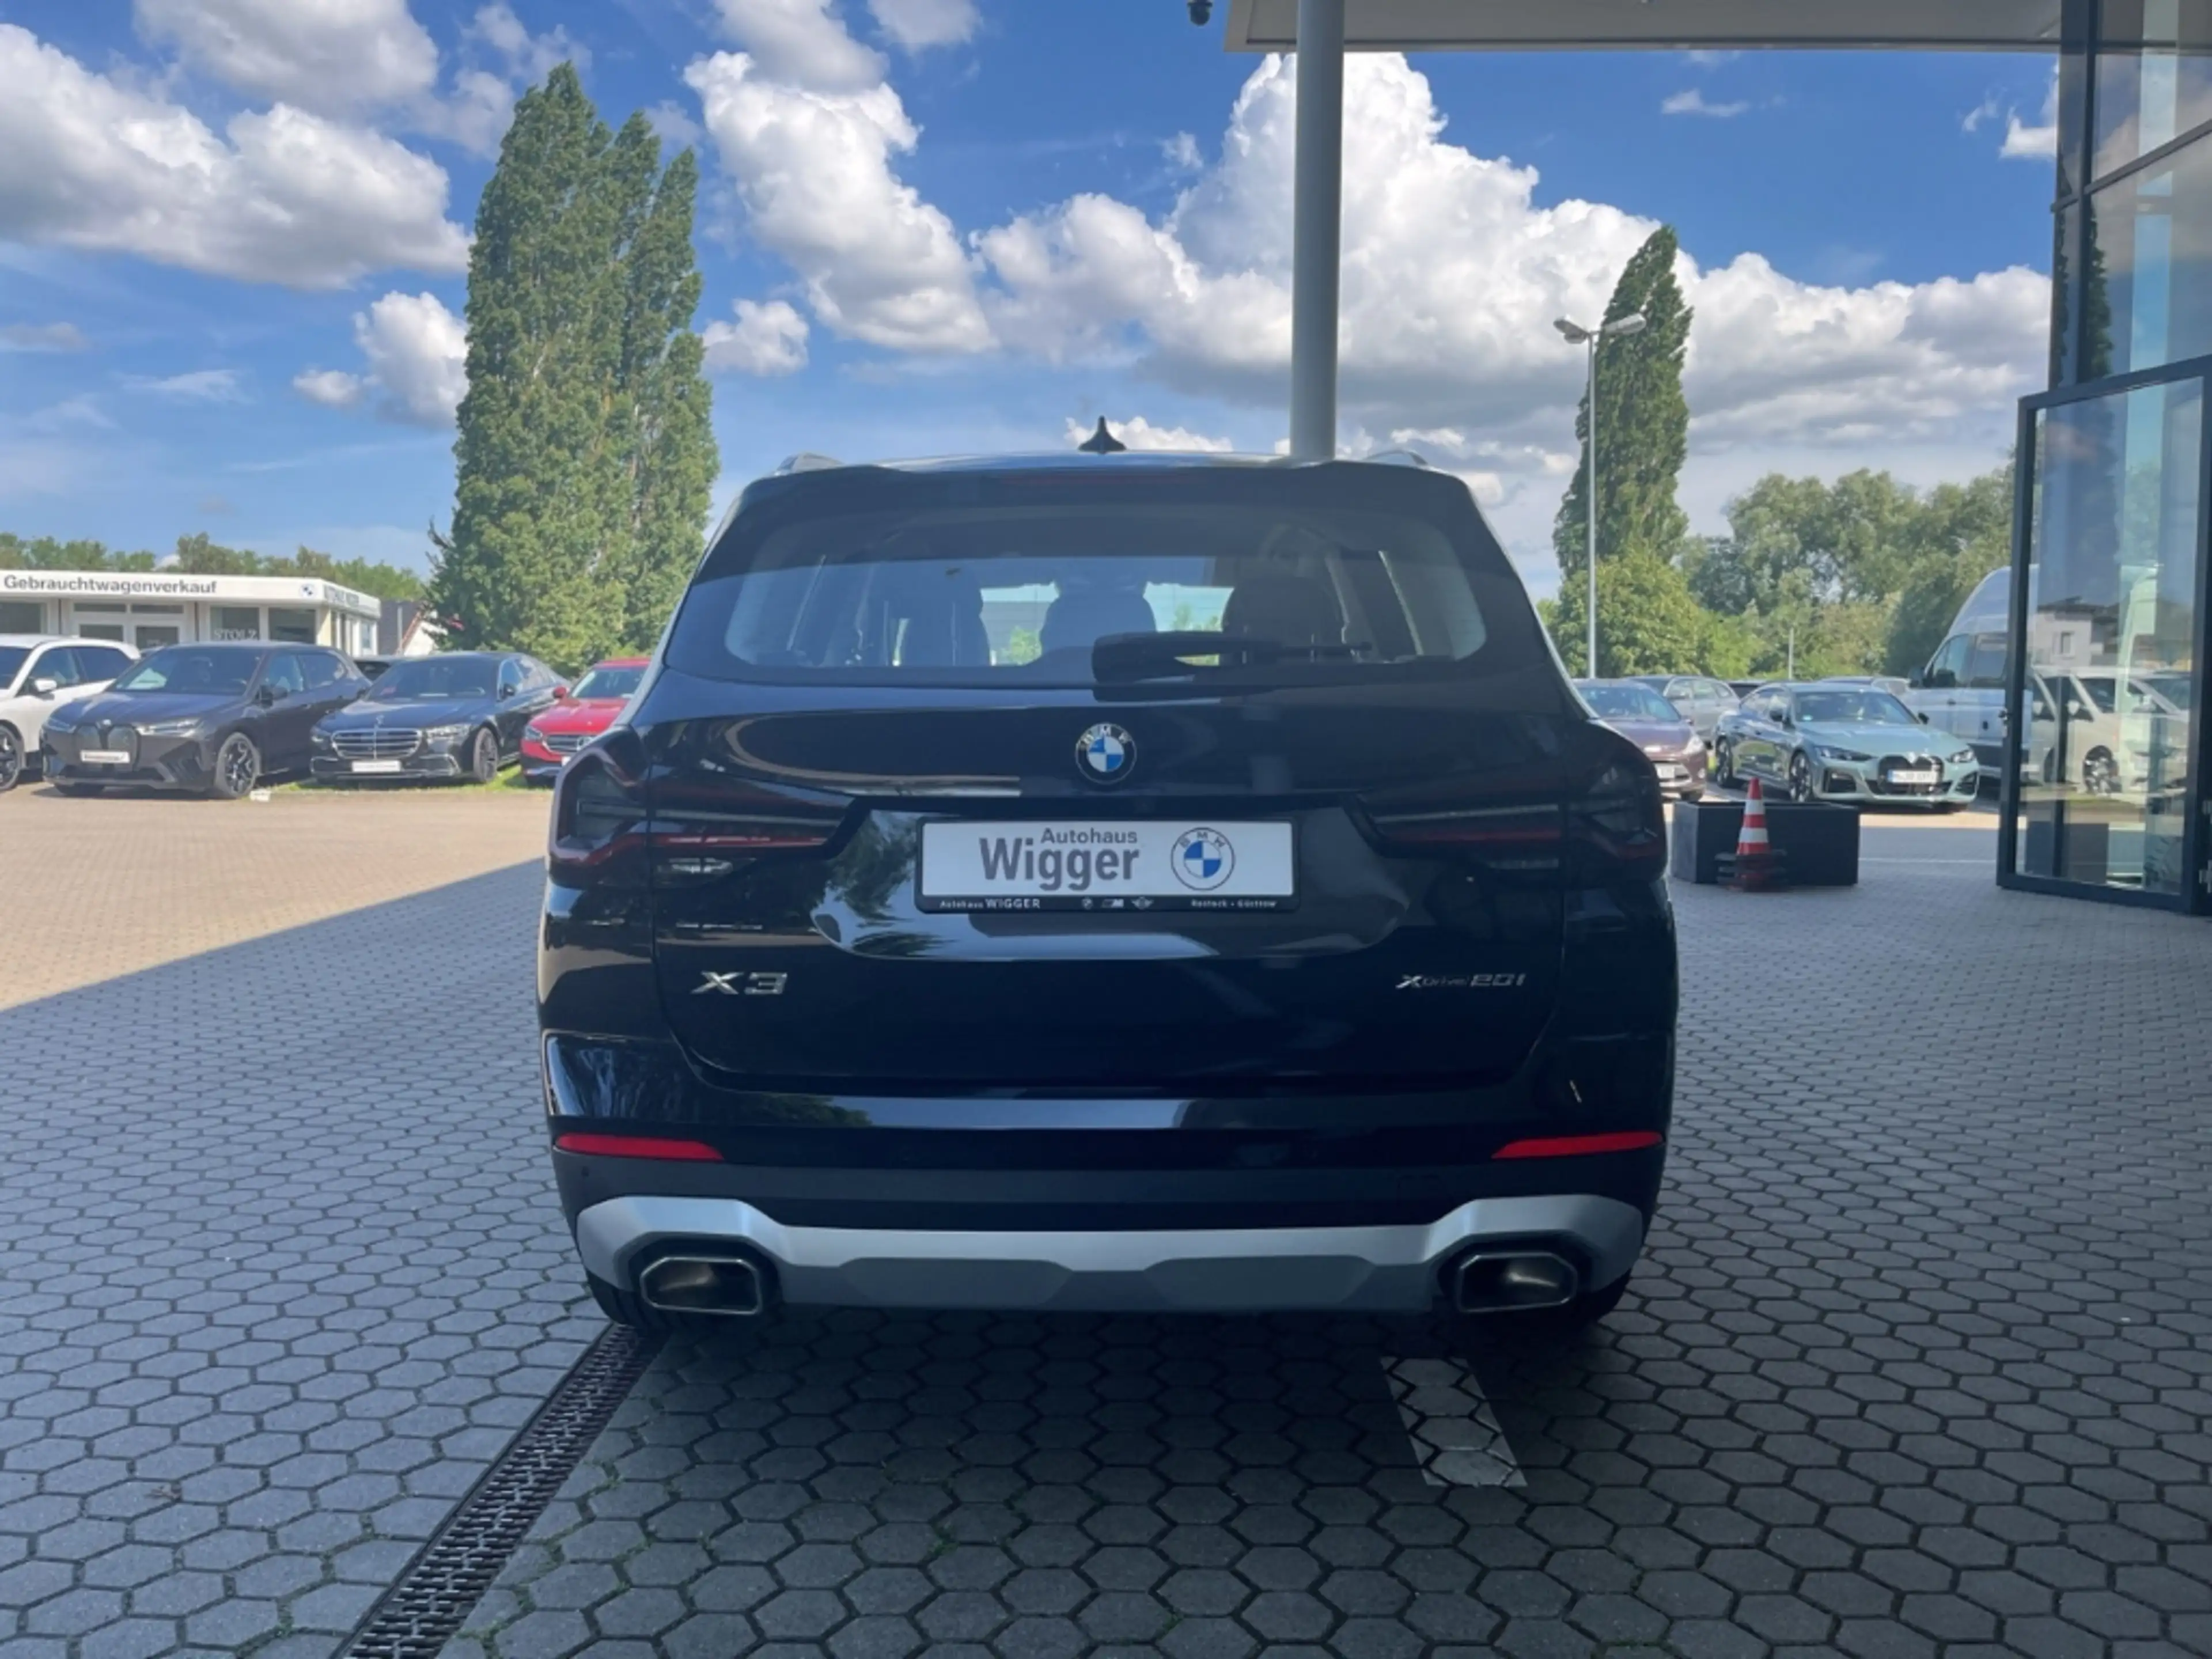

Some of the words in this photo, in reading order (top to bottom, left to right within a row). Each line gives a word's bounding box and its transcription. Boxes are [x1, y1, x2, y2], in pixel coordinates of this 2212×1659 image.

[3, 574, 217, 594] Gebrauchtwagenverkauf
[1080, 725, 1131, 745] BMW
[1040, 828, 1138, 844] Autohaus
[1178, 831, 1225, 849] BMW
[980, 837, 1139, 891] Wigger
[985, 898, 1041, 910] WIGGER
[690, 971, 788, 995] X3
